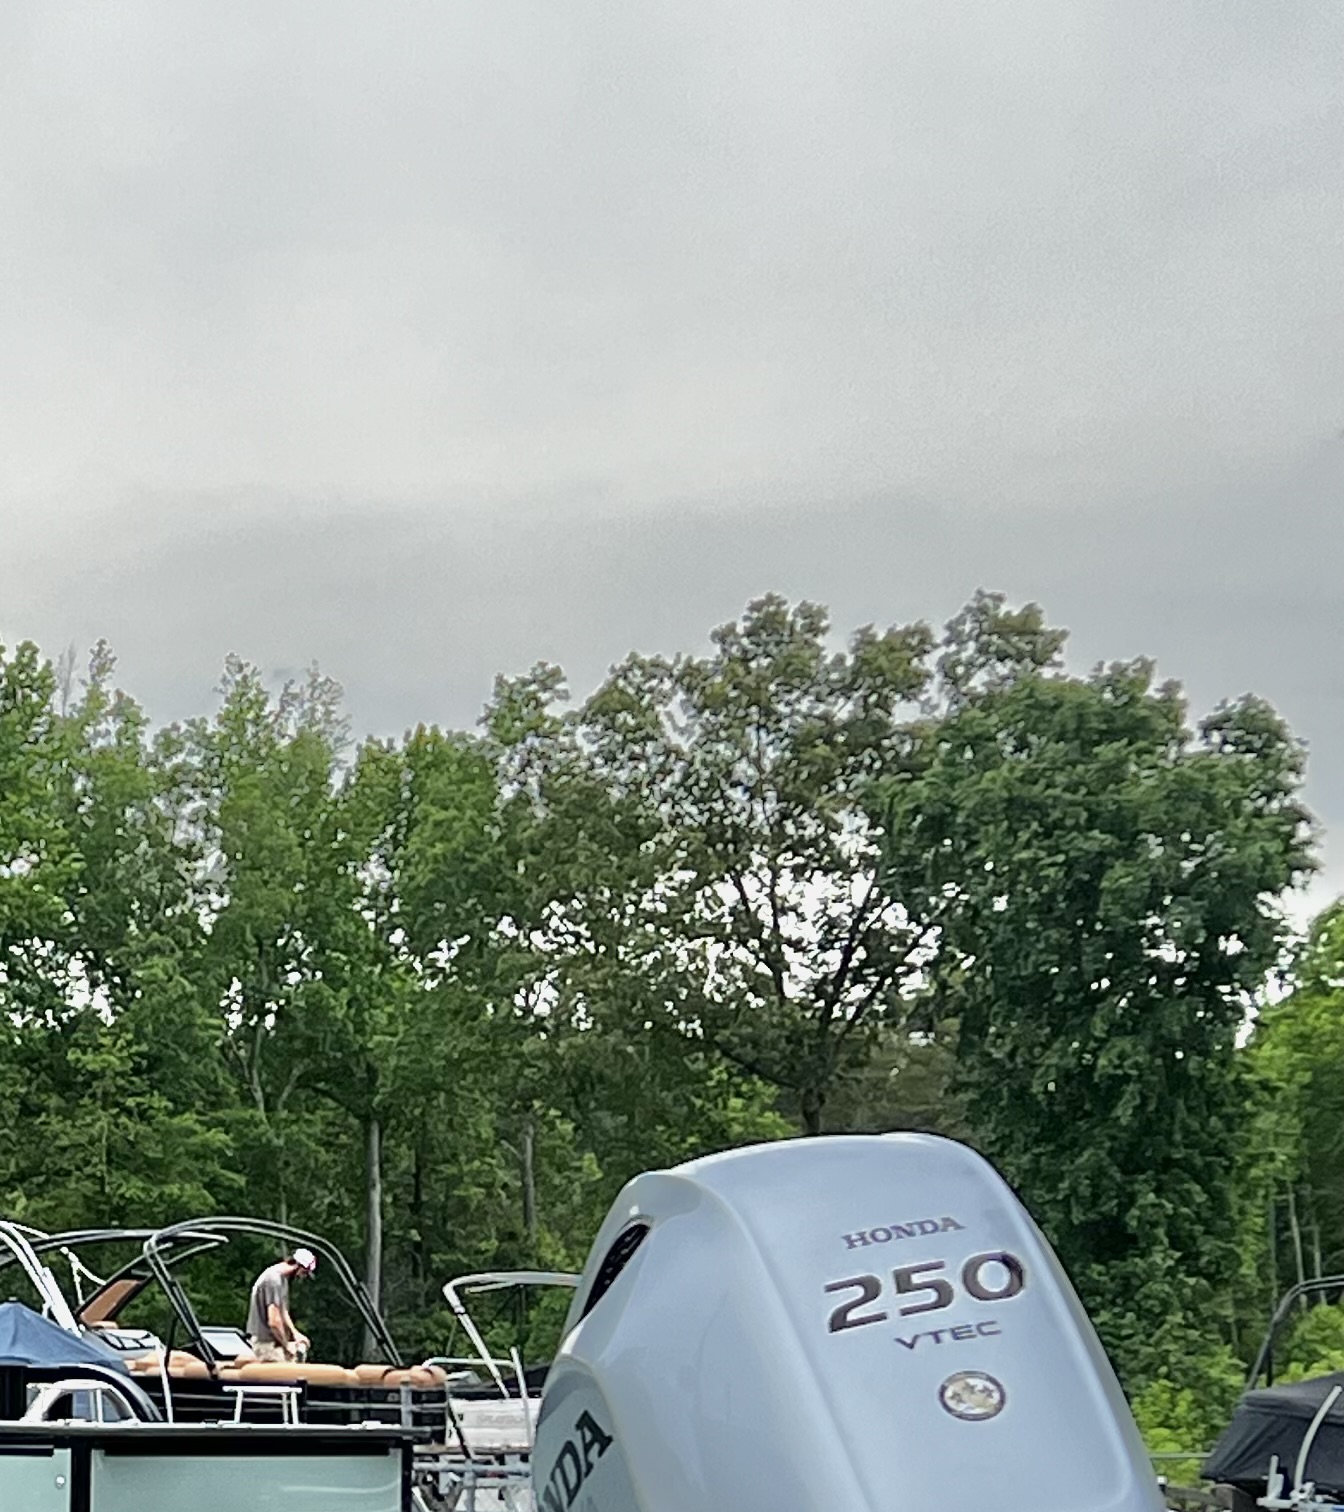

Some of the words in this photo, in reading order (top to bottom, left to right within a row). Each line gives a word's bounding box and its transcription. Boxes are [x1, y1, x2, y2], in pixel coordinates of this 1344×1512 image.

[841, 1217, 965, 1249] HONDA
[824, 1251, 1024, 1333] 250
[894, 1320, 1002, 1350] VTEC
